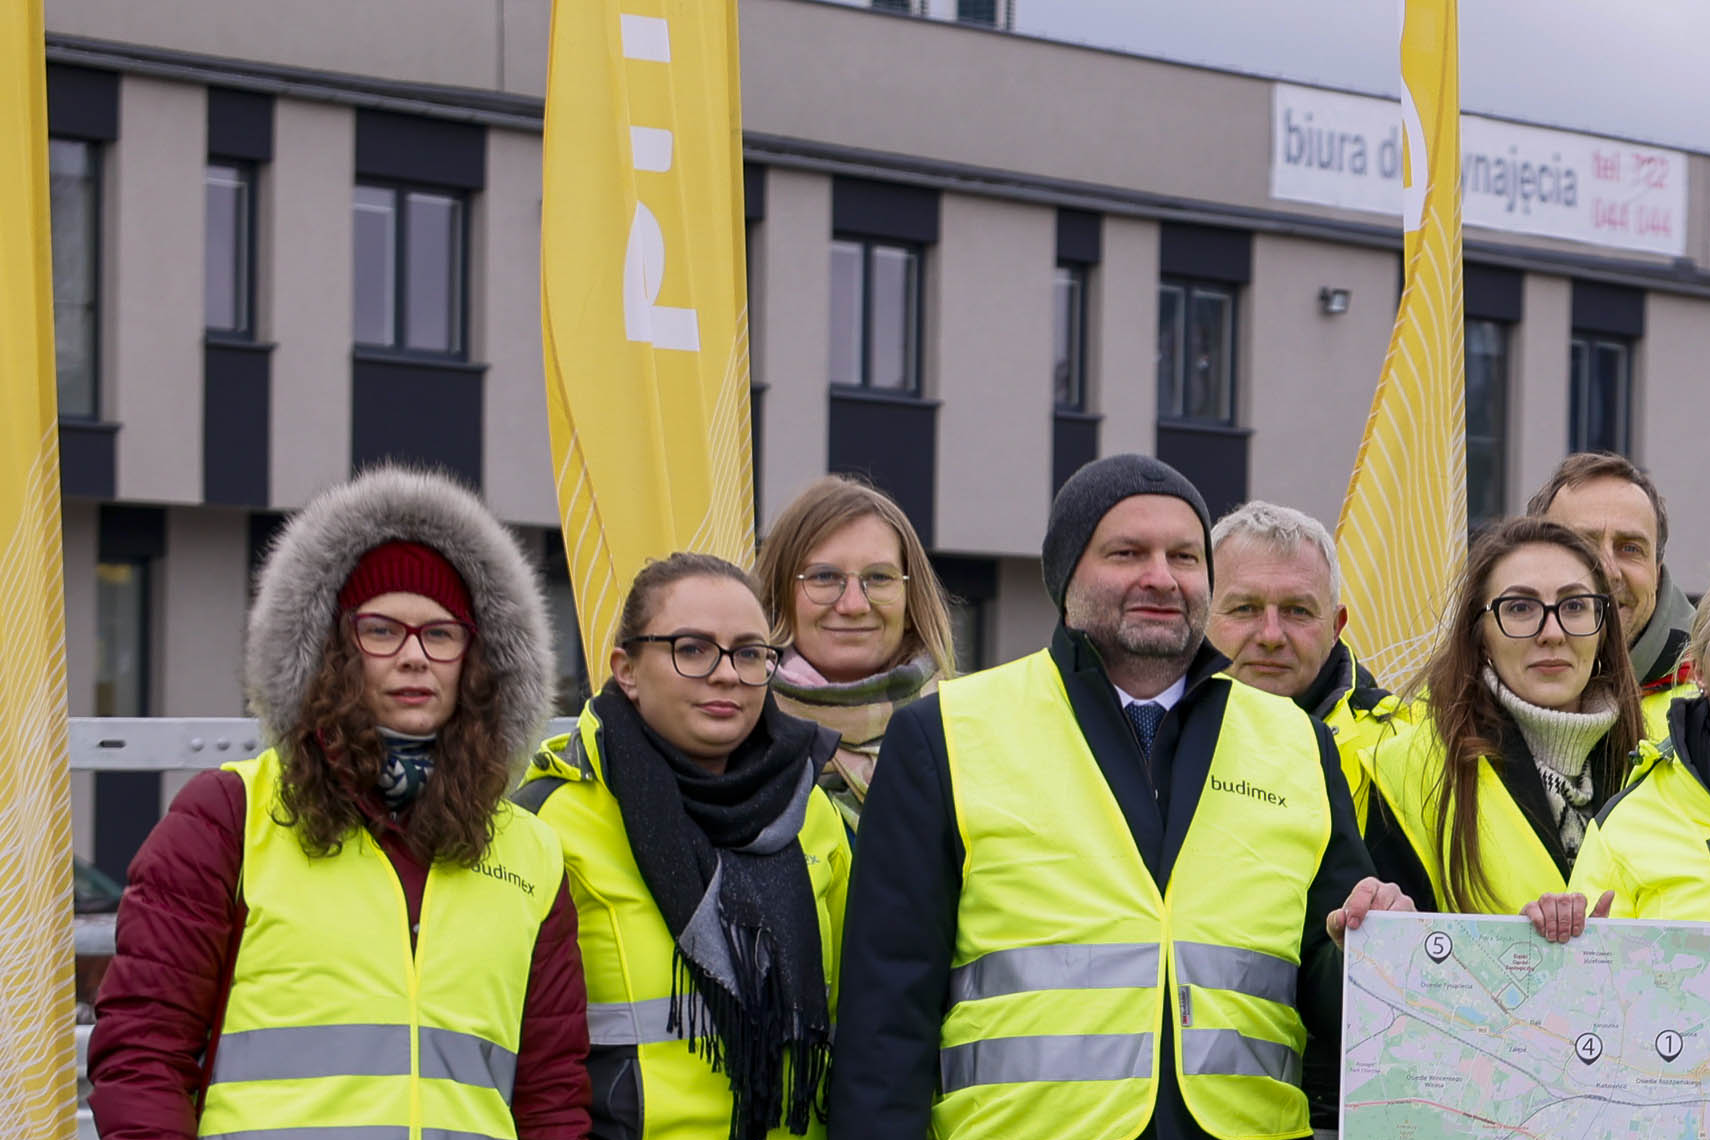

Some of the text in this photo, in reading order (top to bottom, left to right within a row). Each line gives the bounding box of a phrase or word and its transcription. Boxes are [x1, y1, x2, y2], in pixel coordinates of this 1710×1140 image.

[1284, 107, 1367, 177] biura
[1210, 774, 1288, 809] budimex
[1433, 937, 1445, 954] 5
[1582, 1038, 1595, 1055] 4
[1666, 1036, 1673, 1053] 1
